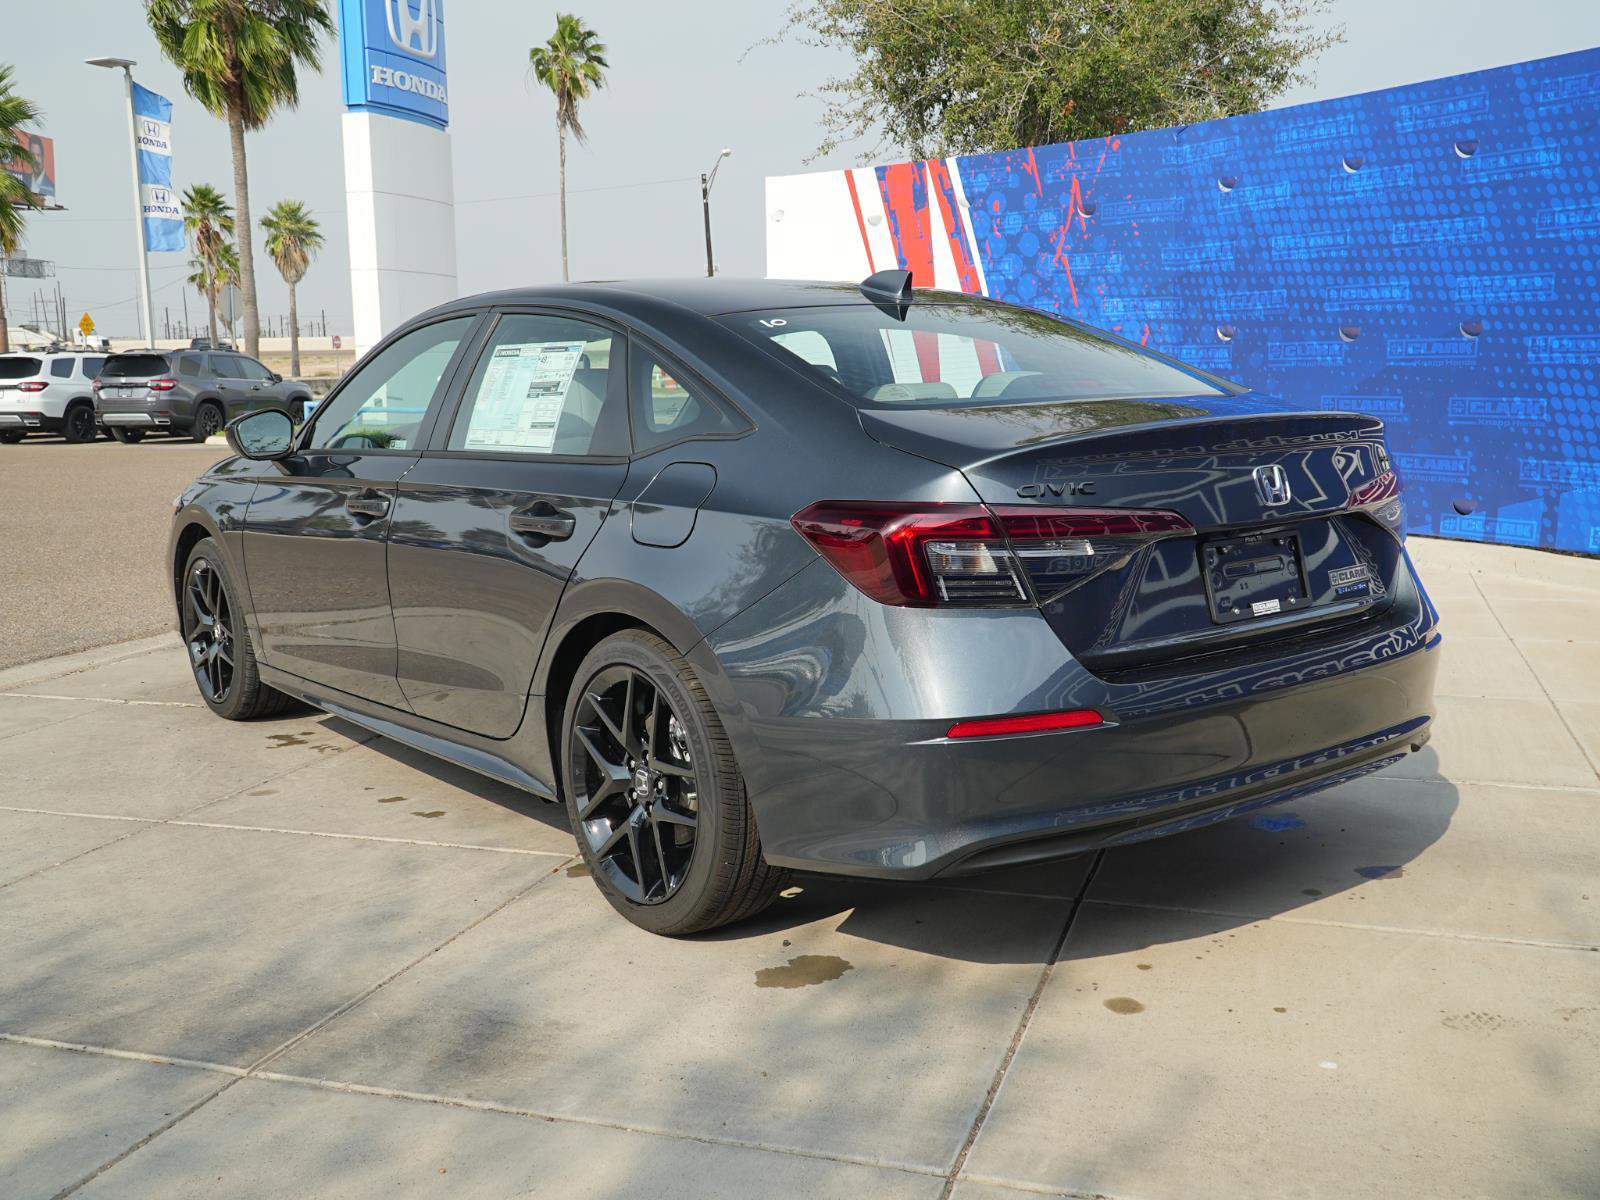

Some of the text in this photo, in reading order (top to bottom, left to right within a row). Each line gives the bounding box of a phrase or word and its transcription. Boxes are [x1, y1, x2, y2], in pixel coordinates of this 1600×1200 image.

[371, 65, 447, 105] HONDA
[143, 205, 180, 215] HONDA
[1016, 481, 1096, 498] CIVIC
[1339, 568, 1365, 581] CLARK
